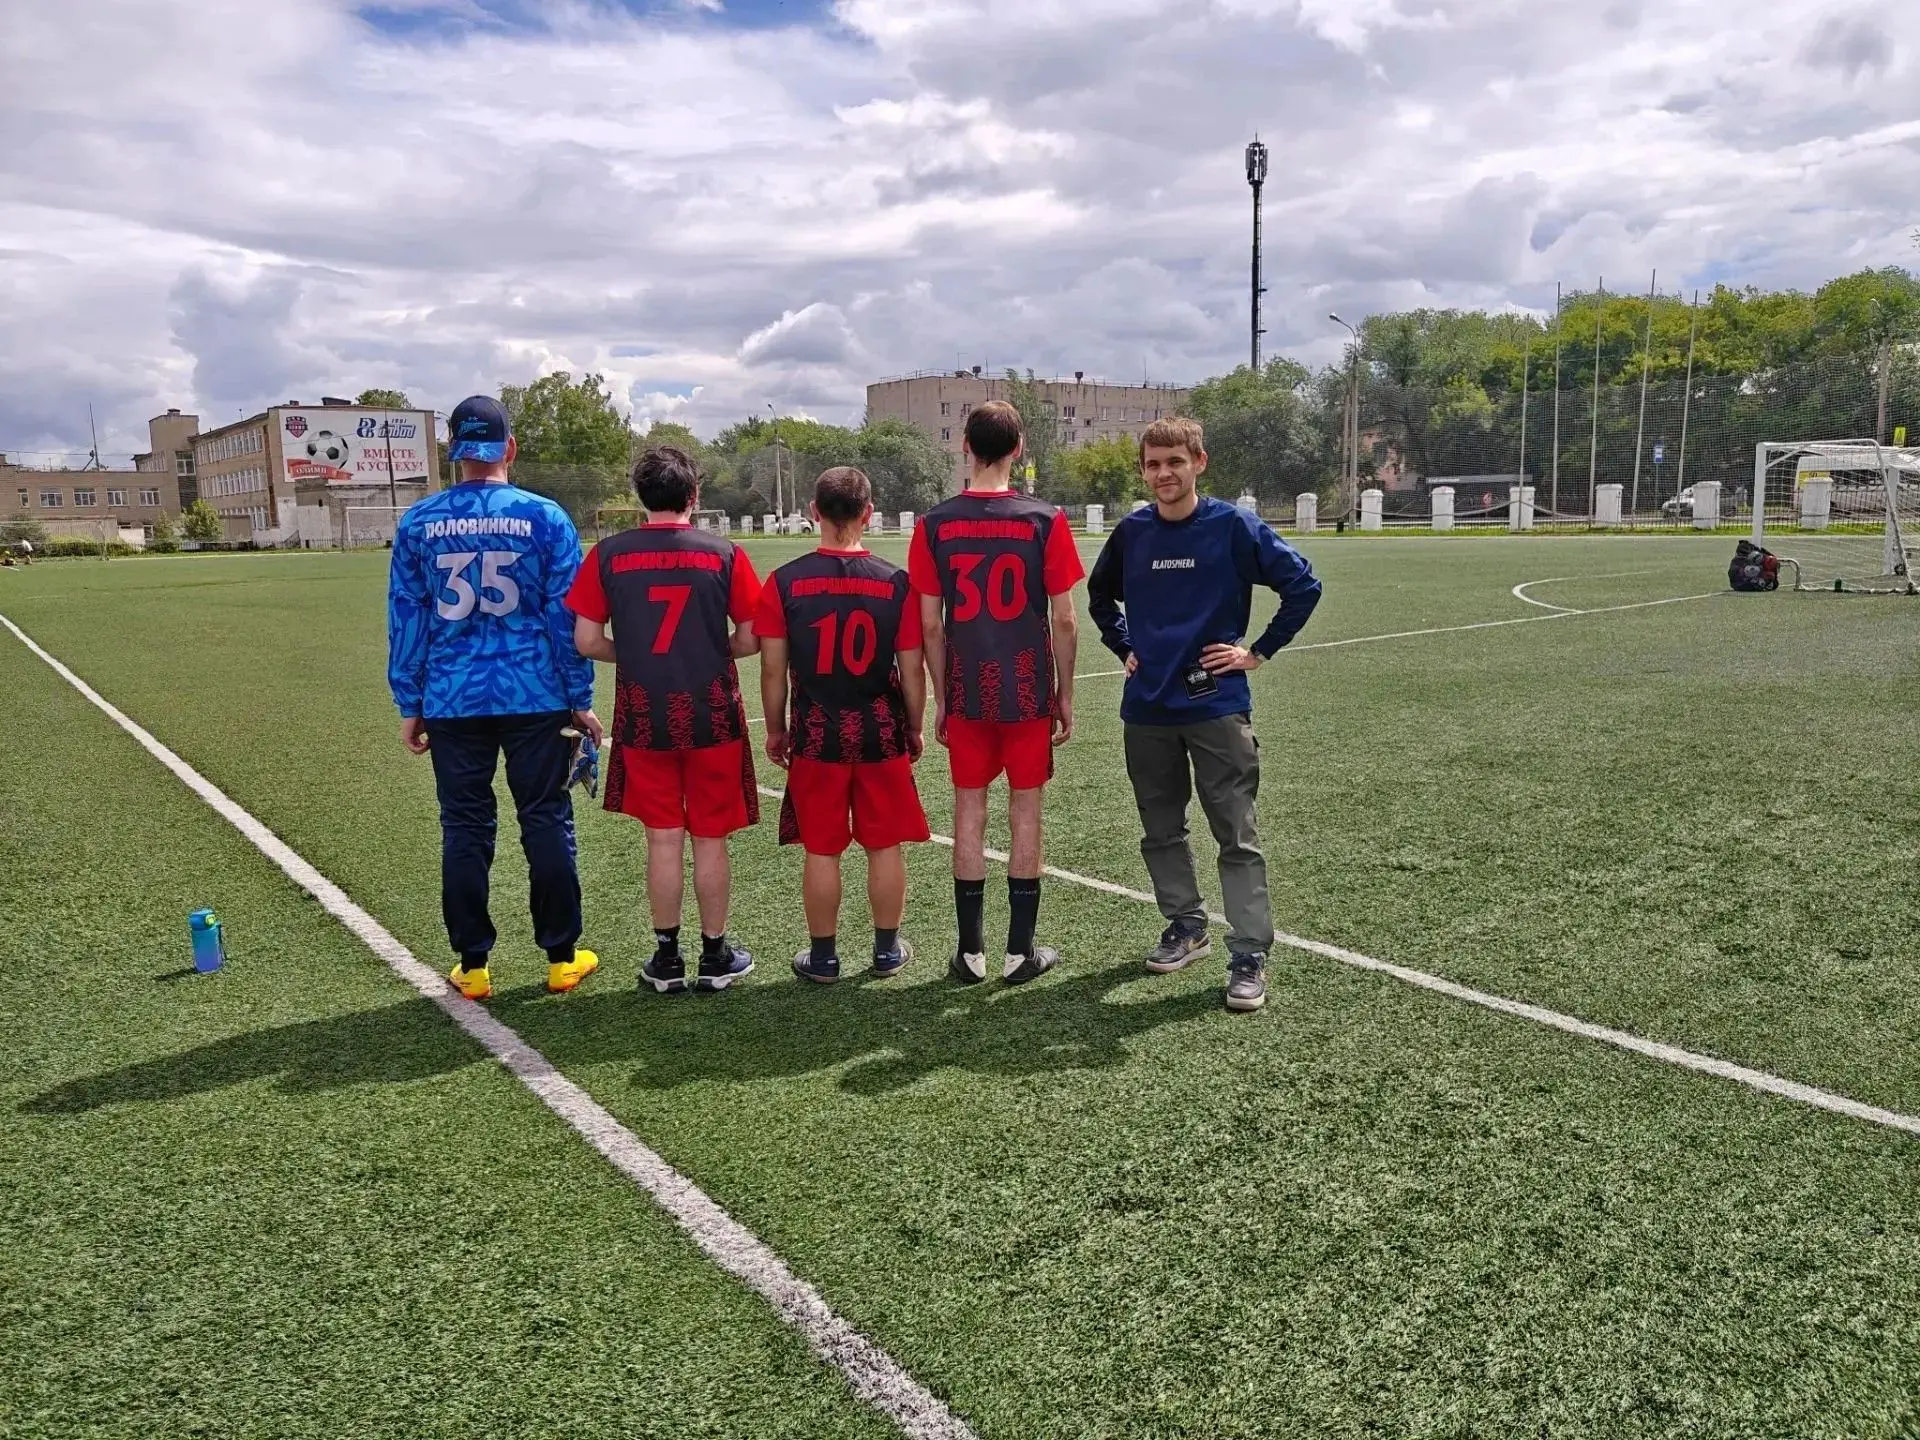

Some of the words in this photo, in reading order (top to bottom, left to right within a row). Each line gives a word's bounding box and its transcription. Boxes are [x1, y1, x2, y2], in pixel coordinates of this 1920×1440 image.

[356, 461, 365, 471] К
[424, 517, 532, 540] ПОЛОВИНКИН
[436, 551, 524, 621] 35
[949, 553, 1028, 621] 30
[1151, 558, 1195, 569] BLATOSPHERA
[648, 585, 692, 654] 7
[808, 609, 877, 676] 10
